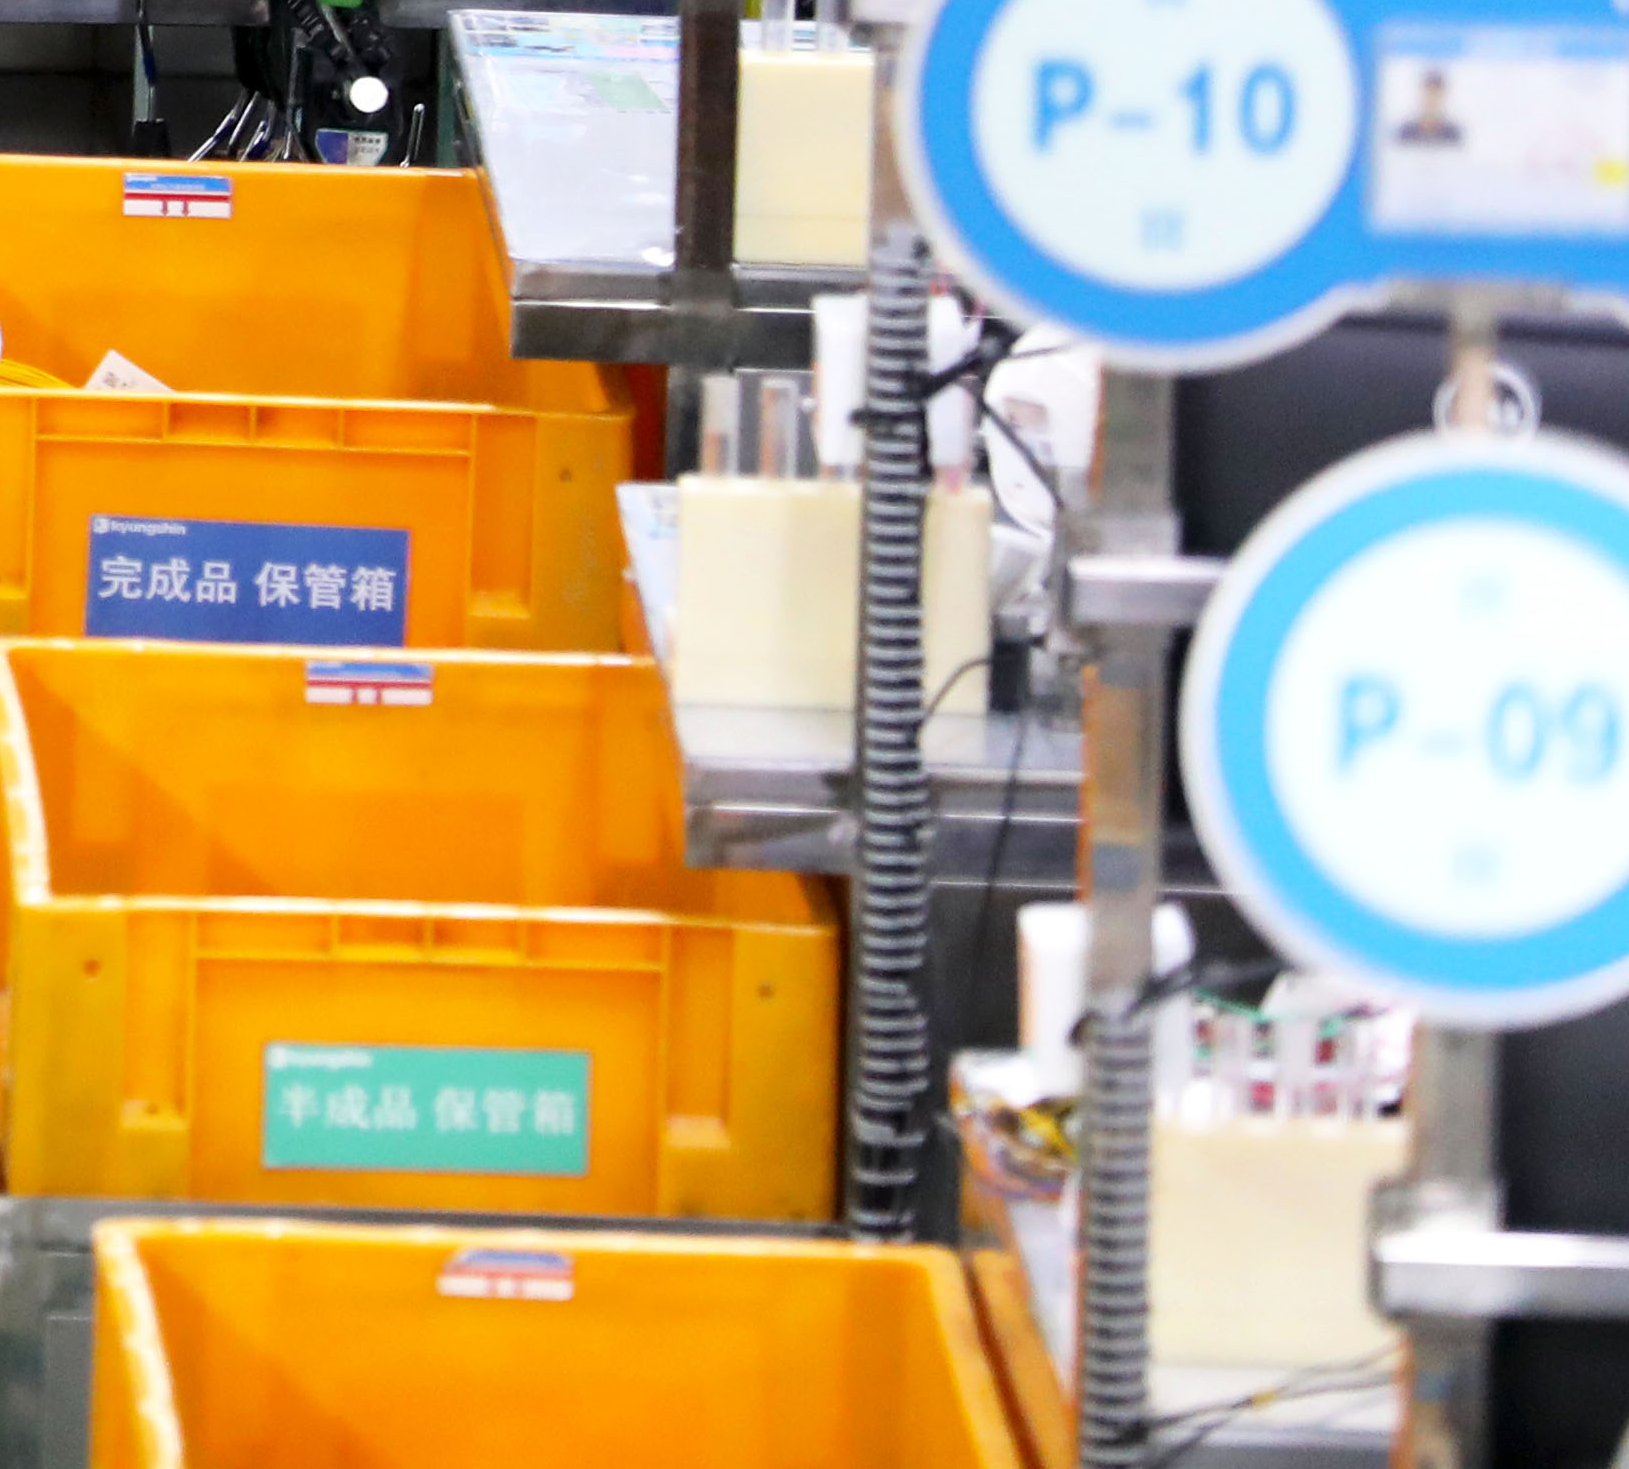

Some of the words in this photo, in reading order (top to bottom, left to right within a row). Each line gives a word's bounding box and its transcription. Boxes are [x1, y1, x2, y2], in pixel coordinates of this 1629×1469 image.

[1031, 60, 1297, 155] P-10
[97, 555, 239, 605] 完成品
[254, 561, 398, 612] 保管箱
[1338, 676, 1619, 784] P-09
[280, 1081, 418, 1130] 半成品
[433, 1086, 576, 1136] 保管箱
